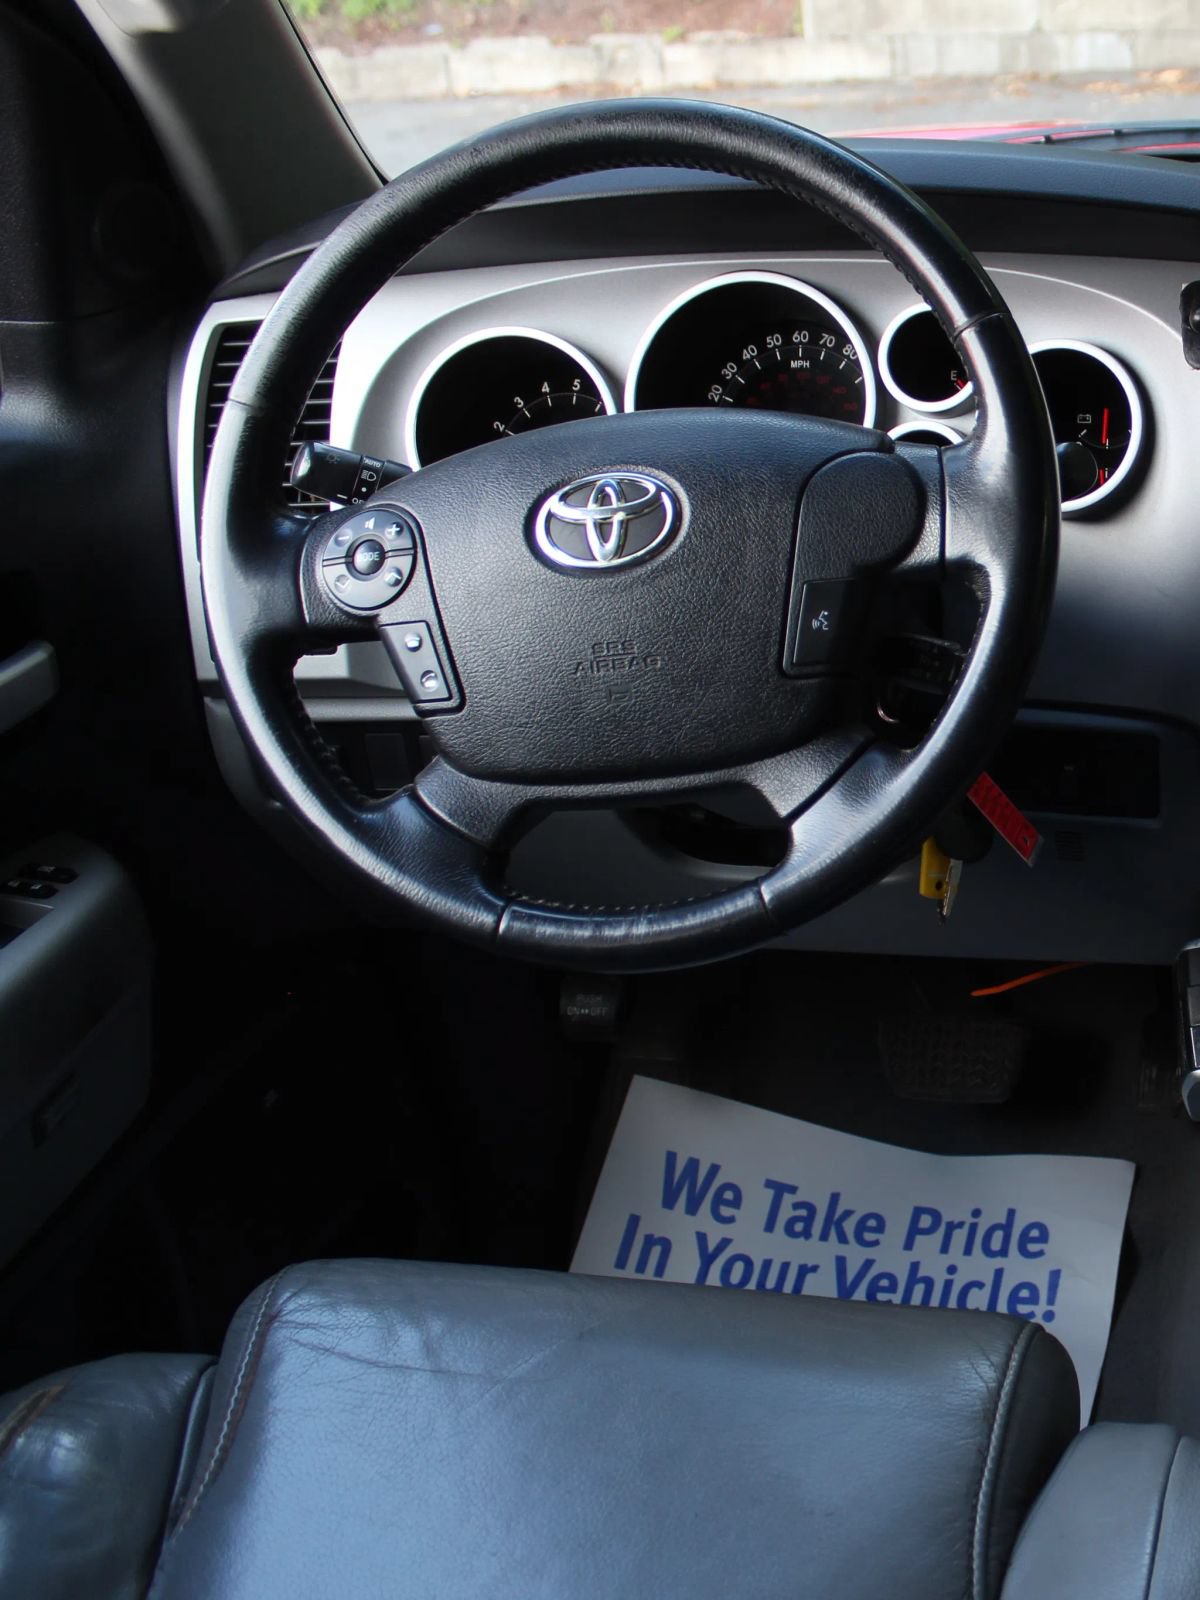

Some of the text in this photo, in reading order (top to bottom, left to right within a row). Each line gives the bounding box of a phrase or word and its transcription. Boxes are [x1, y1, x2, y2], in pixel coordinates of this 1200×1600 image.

[766, 334, 782, 348] 50
[792, 331, 809, 343] 60
[819, 333, 836, 348] 70
[742, 345, 758, 360] 40
[842, 344, 858, 360] 80
[721, 362, 737, 379] 30
[790, 360, 810, 368] MPH
[951, 370, 957, 380] E
[541, 381, 550, 393] 4
[572, 379, 581, 391] 5
[708, 385, 722, 402] 20
[514, 396, 524, 407] 3
[493, 421, 505, 432] 2
[661, 1150, 1050, 1260] We Take Pride
[614, 1213, 1062, 1323] In Your Vehicle!
